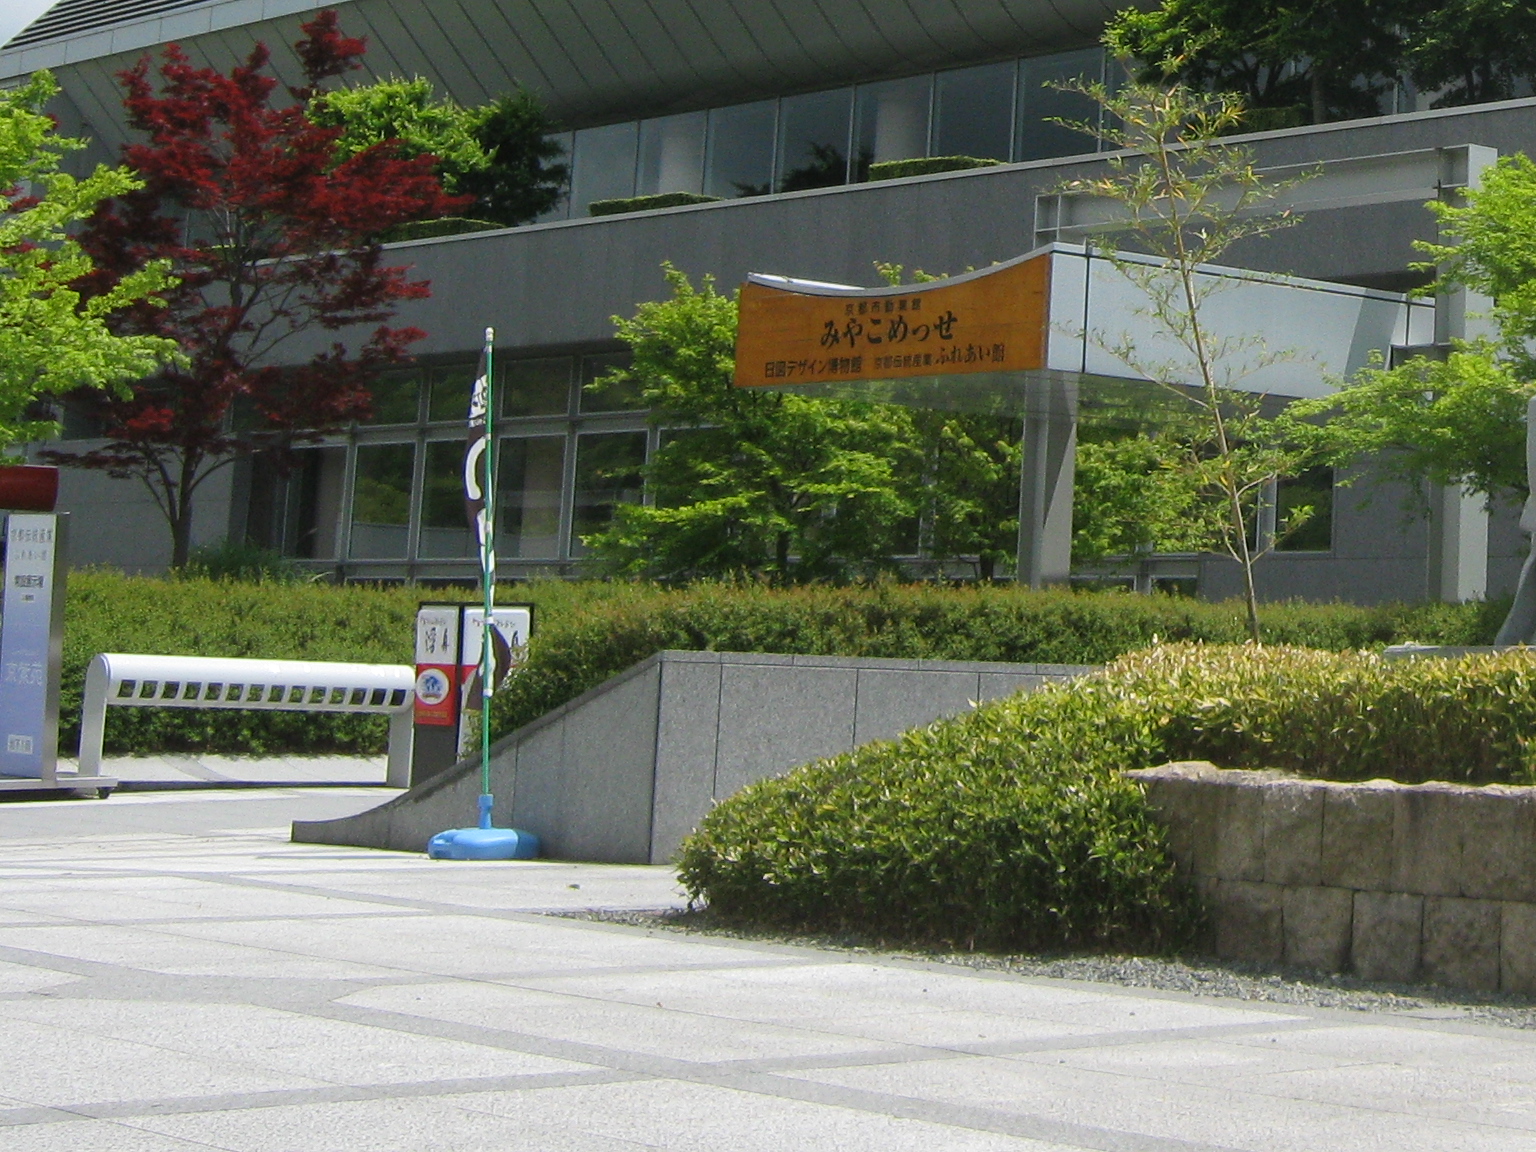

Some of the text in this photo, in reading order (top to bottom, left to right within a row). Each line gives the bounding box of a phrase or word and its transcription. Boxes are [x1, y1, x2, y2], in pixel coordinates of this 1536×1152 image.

[820, 311, 959, 349] みやこめっせ
